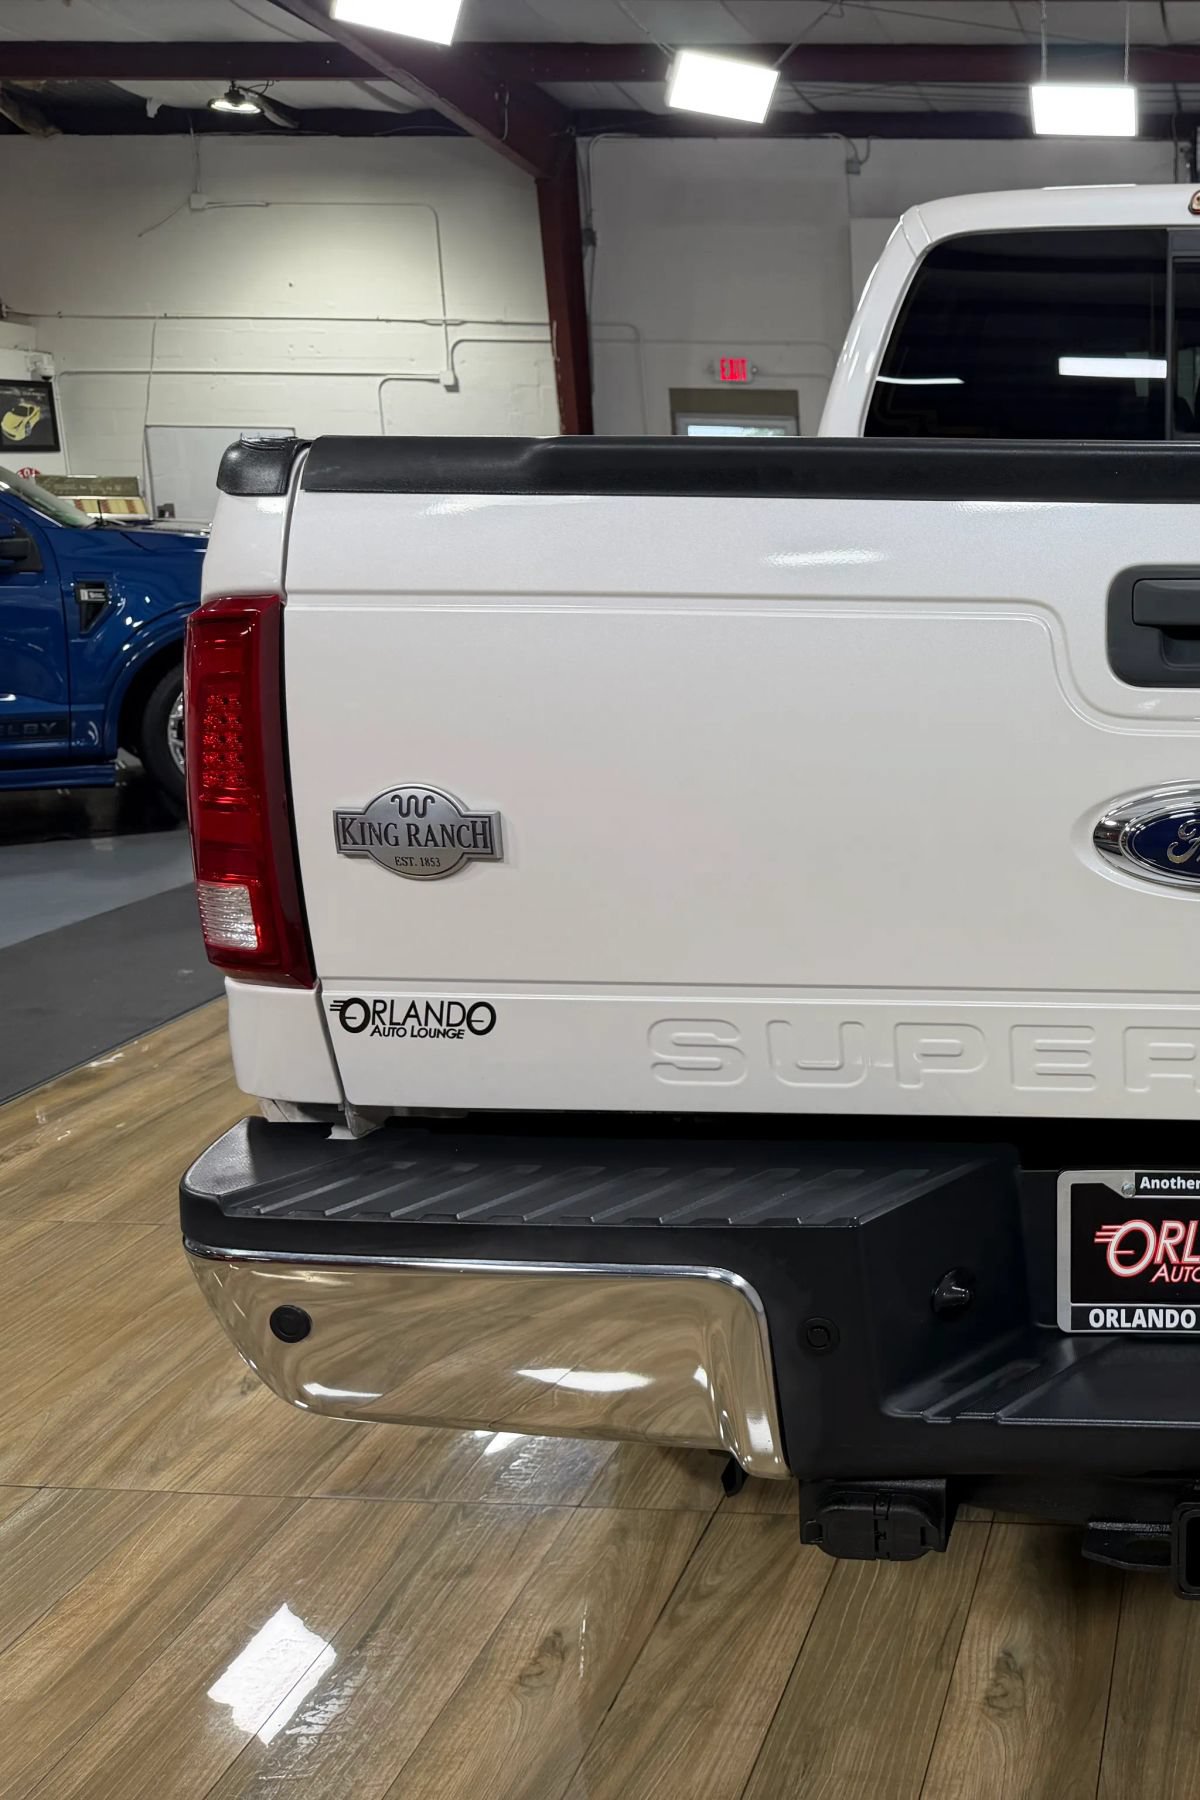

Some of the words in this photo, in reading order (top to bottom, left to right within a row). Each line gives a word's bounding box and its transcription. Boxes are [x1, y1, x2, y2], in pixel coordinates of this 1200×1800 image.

[340, 817, 399, 847] KING
[406, 820, 490, 849] RANCH
[394, 856, 418, 867] EST.
[420, 857, 441, 867] 1853
[336, 997, 497, 1036] ORLANDO
[370, 1025, 407, 1038] AUTO
[410, 1025, 465, 1040] LOUNGE
[1088, 1308, 1197, 1330] ORLANDO
